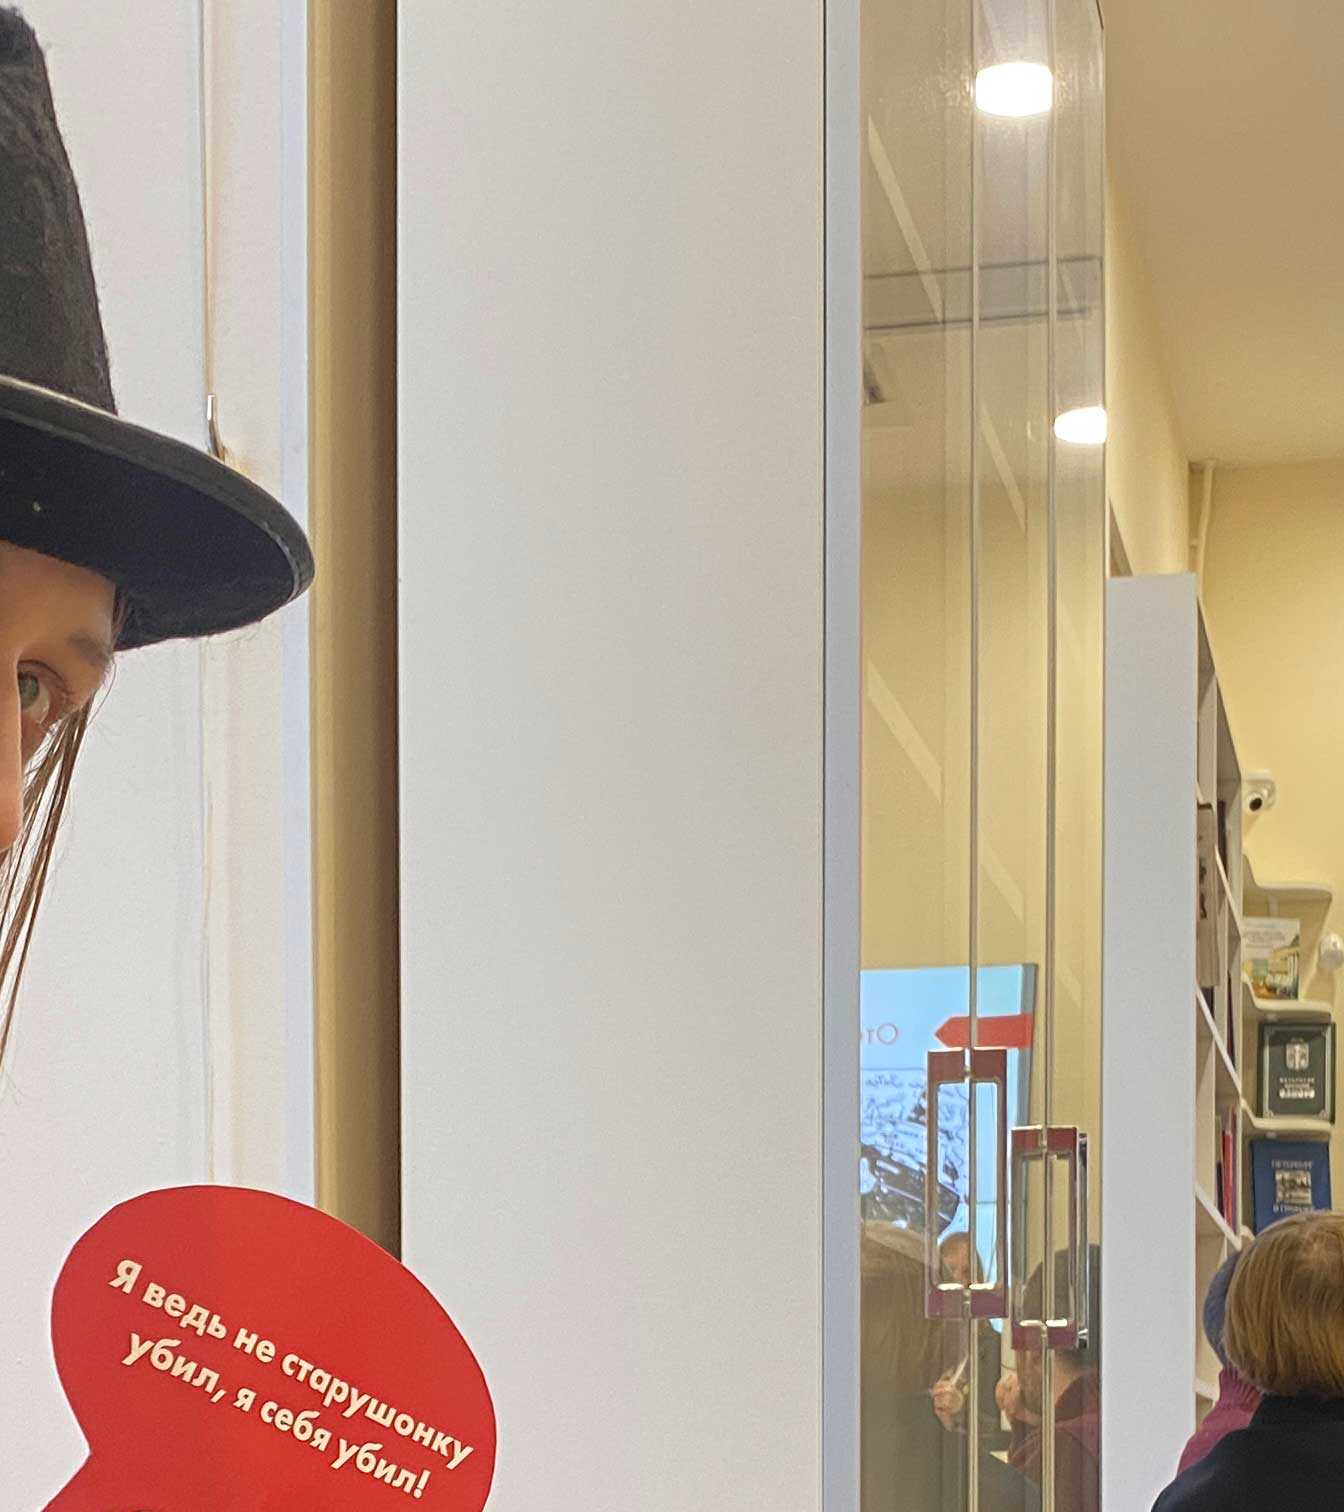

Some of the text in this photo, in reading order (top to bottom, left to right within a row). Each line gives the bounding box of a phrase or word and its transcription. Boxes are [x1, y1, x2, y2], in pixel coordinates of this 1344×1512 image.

[108, 1258, 474, 1470] Я ведь не старушонку
[122, 1331, 432, 1500] убил, я себя убил!
